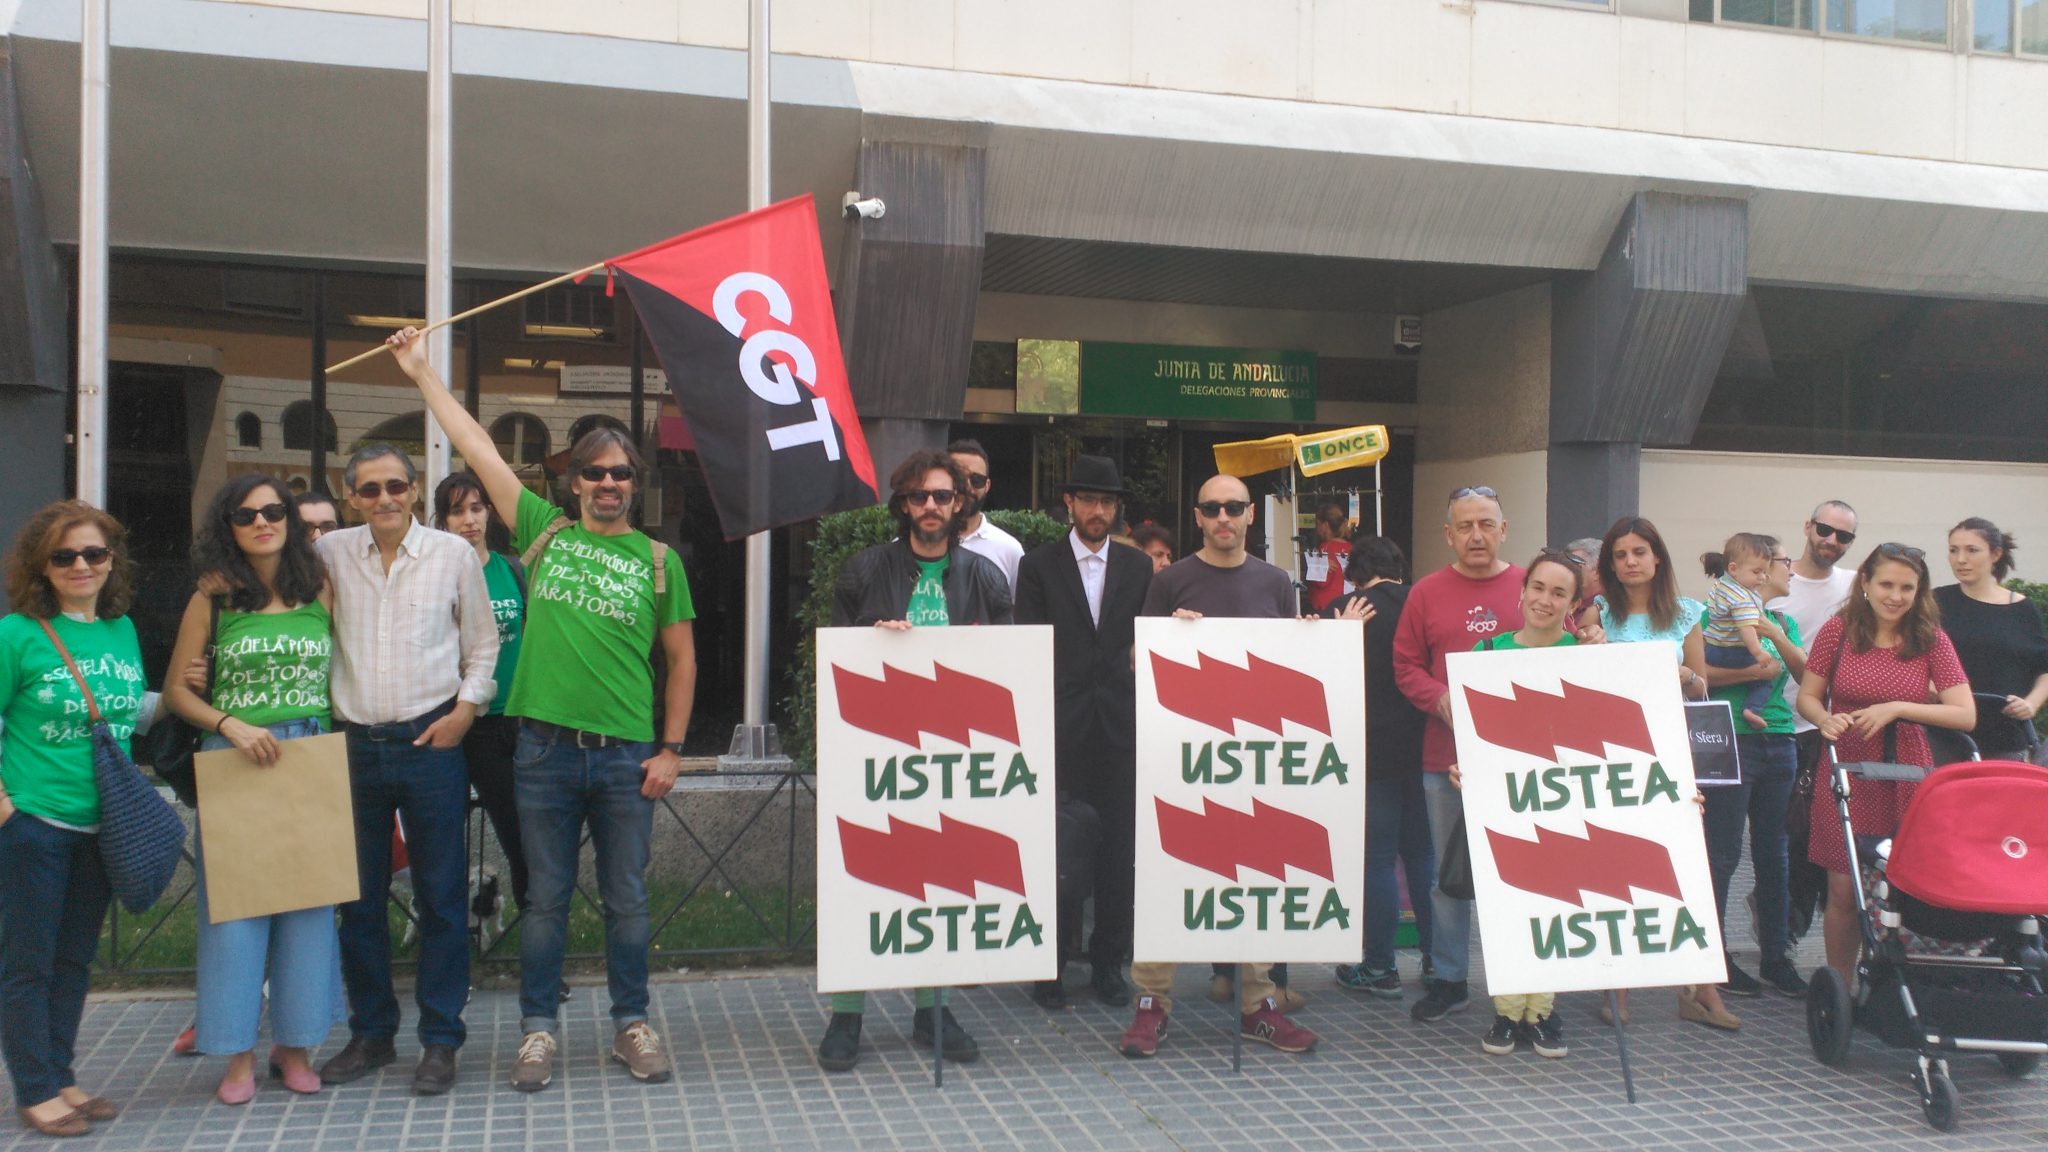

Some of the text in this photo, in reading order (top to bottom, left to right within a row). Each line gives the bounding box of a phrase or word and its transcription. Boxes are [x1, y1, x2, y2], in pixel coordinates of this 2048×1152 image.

[712, 271, 841, 462] CGT
[1154, 359, 1201, 380] JUNTA
[1208, 362, 1226, 381] DE
[1180, 384, 1246, 398] DELEGACIONES
[1324, 432, 1377, 457] ONCE
[548, 564, 574, 580] DE
[232, 669, 262, 685] DE
[64, 698, 89, 715] DE
[217, 690, 268, 710] PARA
[1695, 730, 1723, 744] Sfera
[1181, 740, 1349, 785] USTEA
[864, 751, 1038, 802] USTEA
[1505, 760, 1681, 813] USTEA
[1184, 886, 1350, 931] USTEA
[869, 902, 1043, 957] USTEA
[1529, 906, 1709, 961] USTEA
